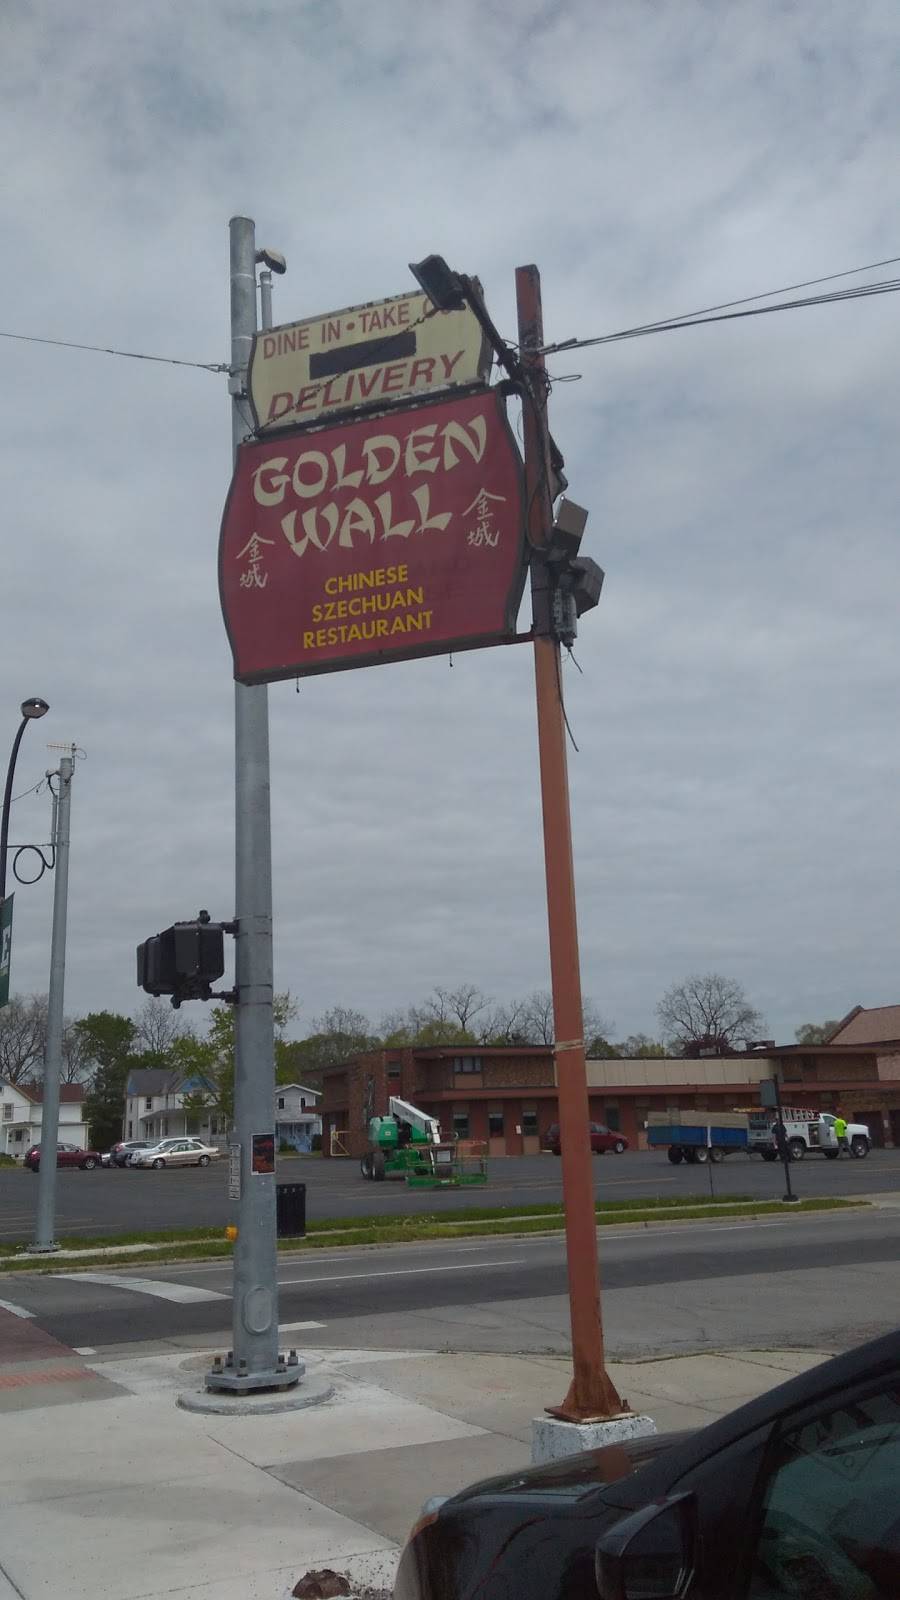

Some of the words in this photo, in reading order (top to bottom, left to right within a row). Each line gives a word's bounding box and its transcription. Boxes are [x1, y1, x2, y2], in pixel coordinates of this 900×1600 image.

[263, 327, 310, 360] DINE
[321, 319, 341, 344] IN
[359, 302, 410, 333] TAKE
[268, 350, 465, 420] DELIVERY
[253, 415, 487, 506] GOLDEN
[280, 484, 453, 557] WALL
[312, 587, 424, 623] SZECHUAN
[324, 564, 409, 595] CHINESE
[303, 611, 433, 649] RESTAURANT
